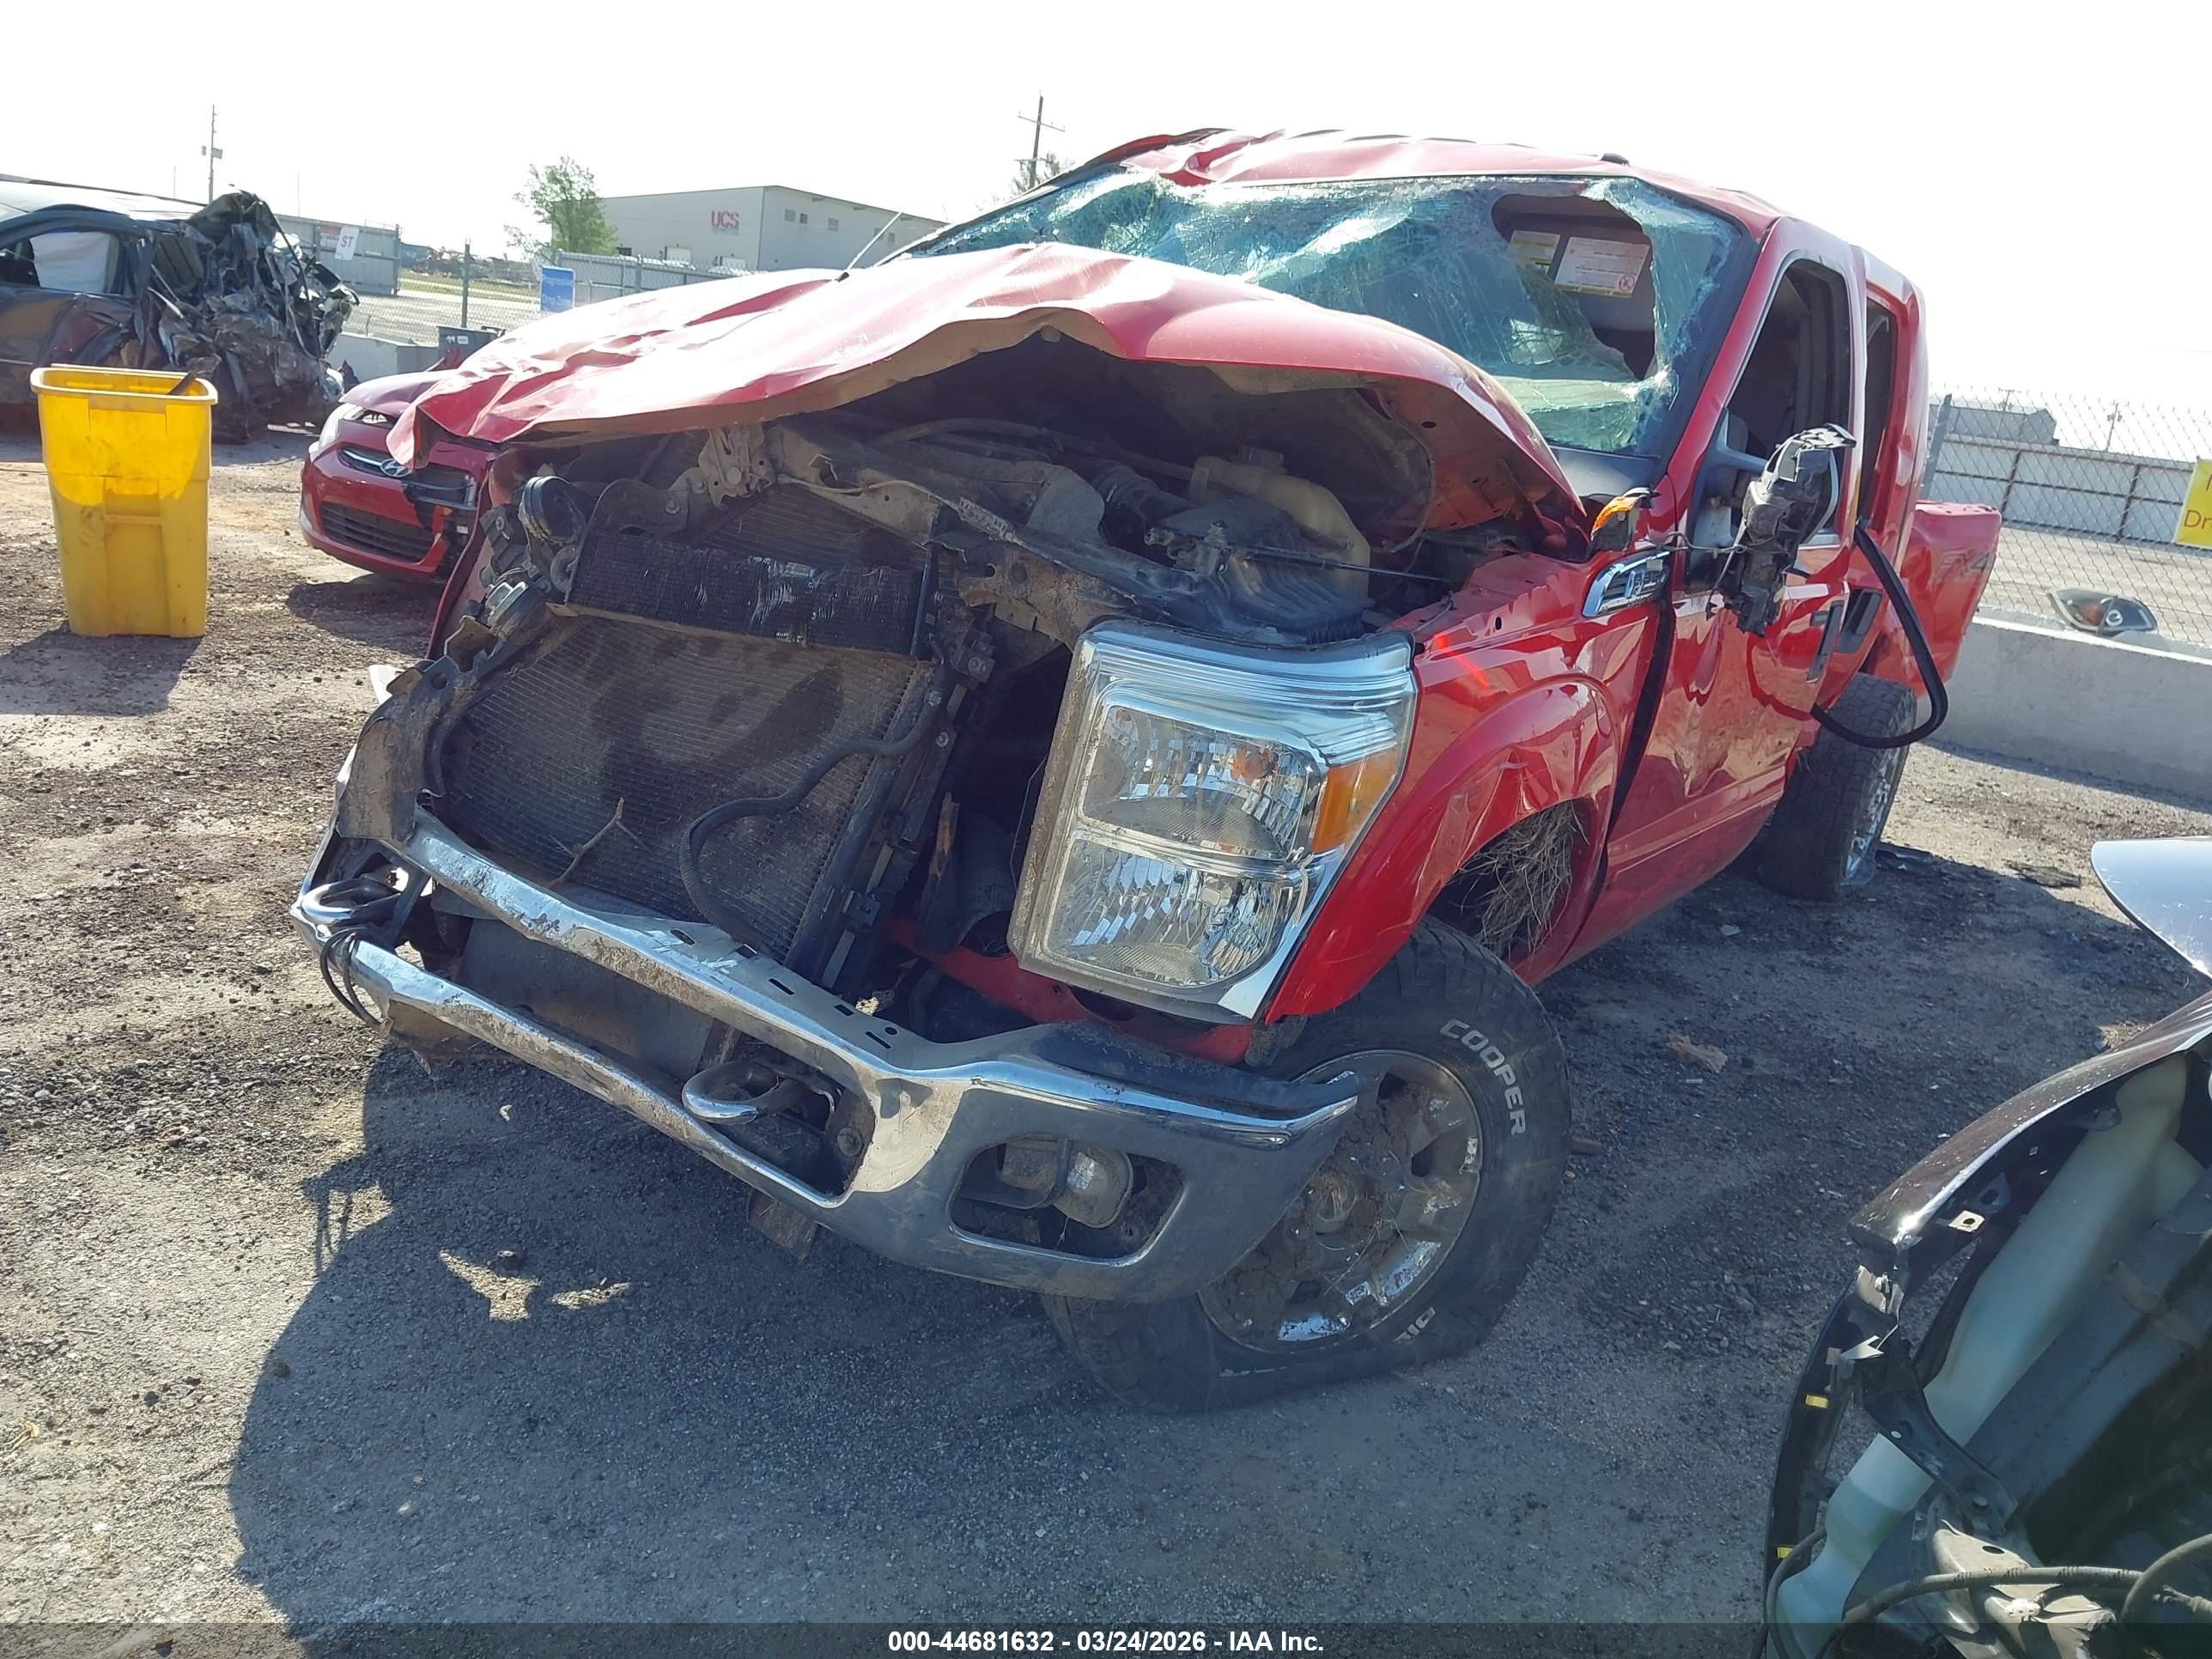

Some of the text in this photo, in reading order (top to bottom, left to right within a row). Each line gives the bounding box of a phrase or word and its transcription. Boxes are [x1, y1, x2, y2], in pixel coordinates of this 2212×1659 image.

[711, 210, 740, 228] UCS
[341, 234, 354, 248] ST
[1937, 550, 1990, 578] FX4
[1440, 1018, 1526, 1136] COOPER
